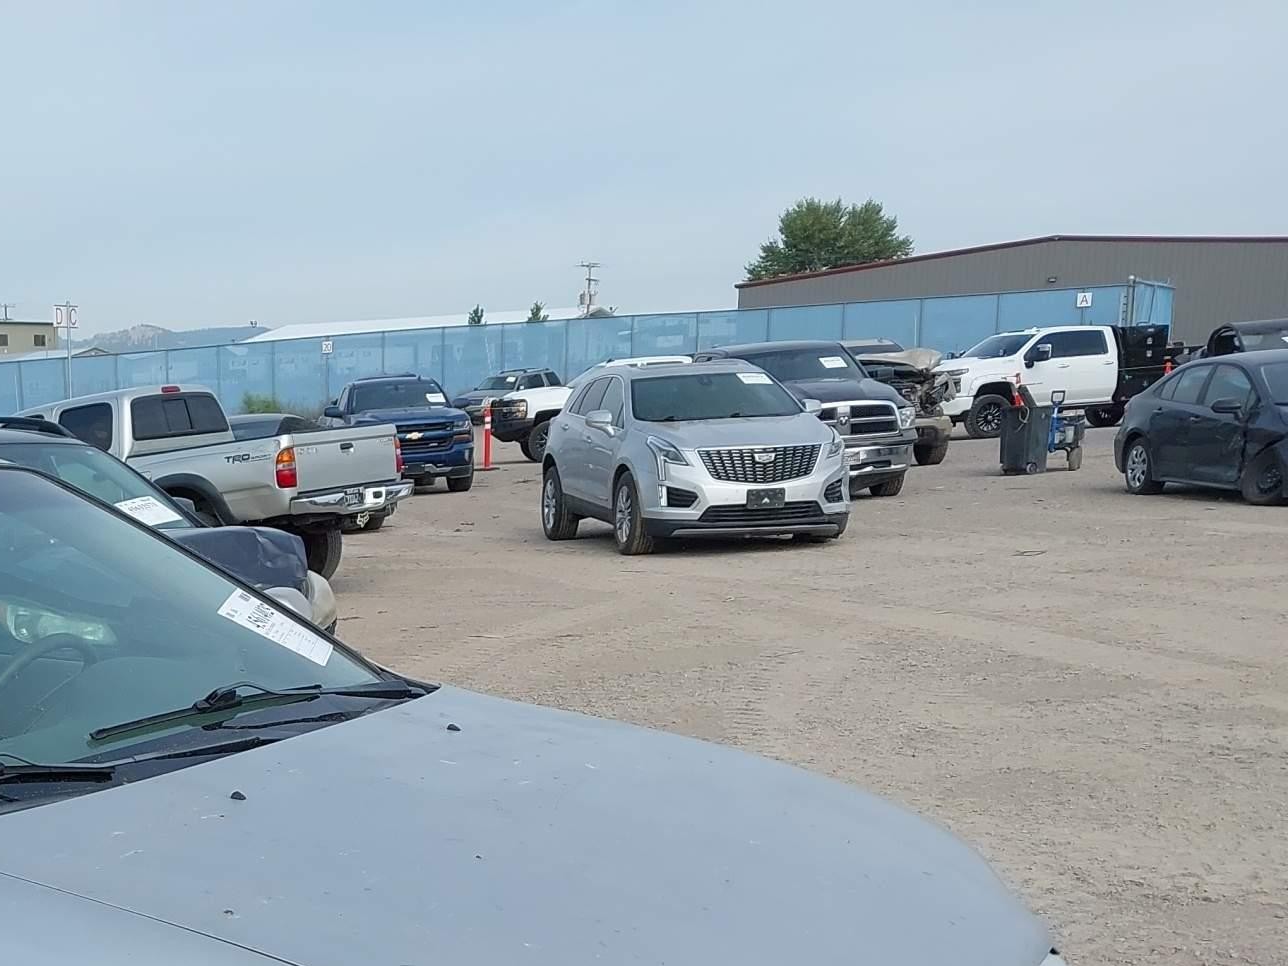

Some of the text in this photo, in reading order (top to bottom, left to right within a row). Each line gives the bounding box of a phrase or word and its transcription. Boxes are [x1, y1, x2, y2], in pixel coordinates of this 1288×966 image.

[1079, 294, 1089, 305] A
[55, 307, 78, 326] D C
